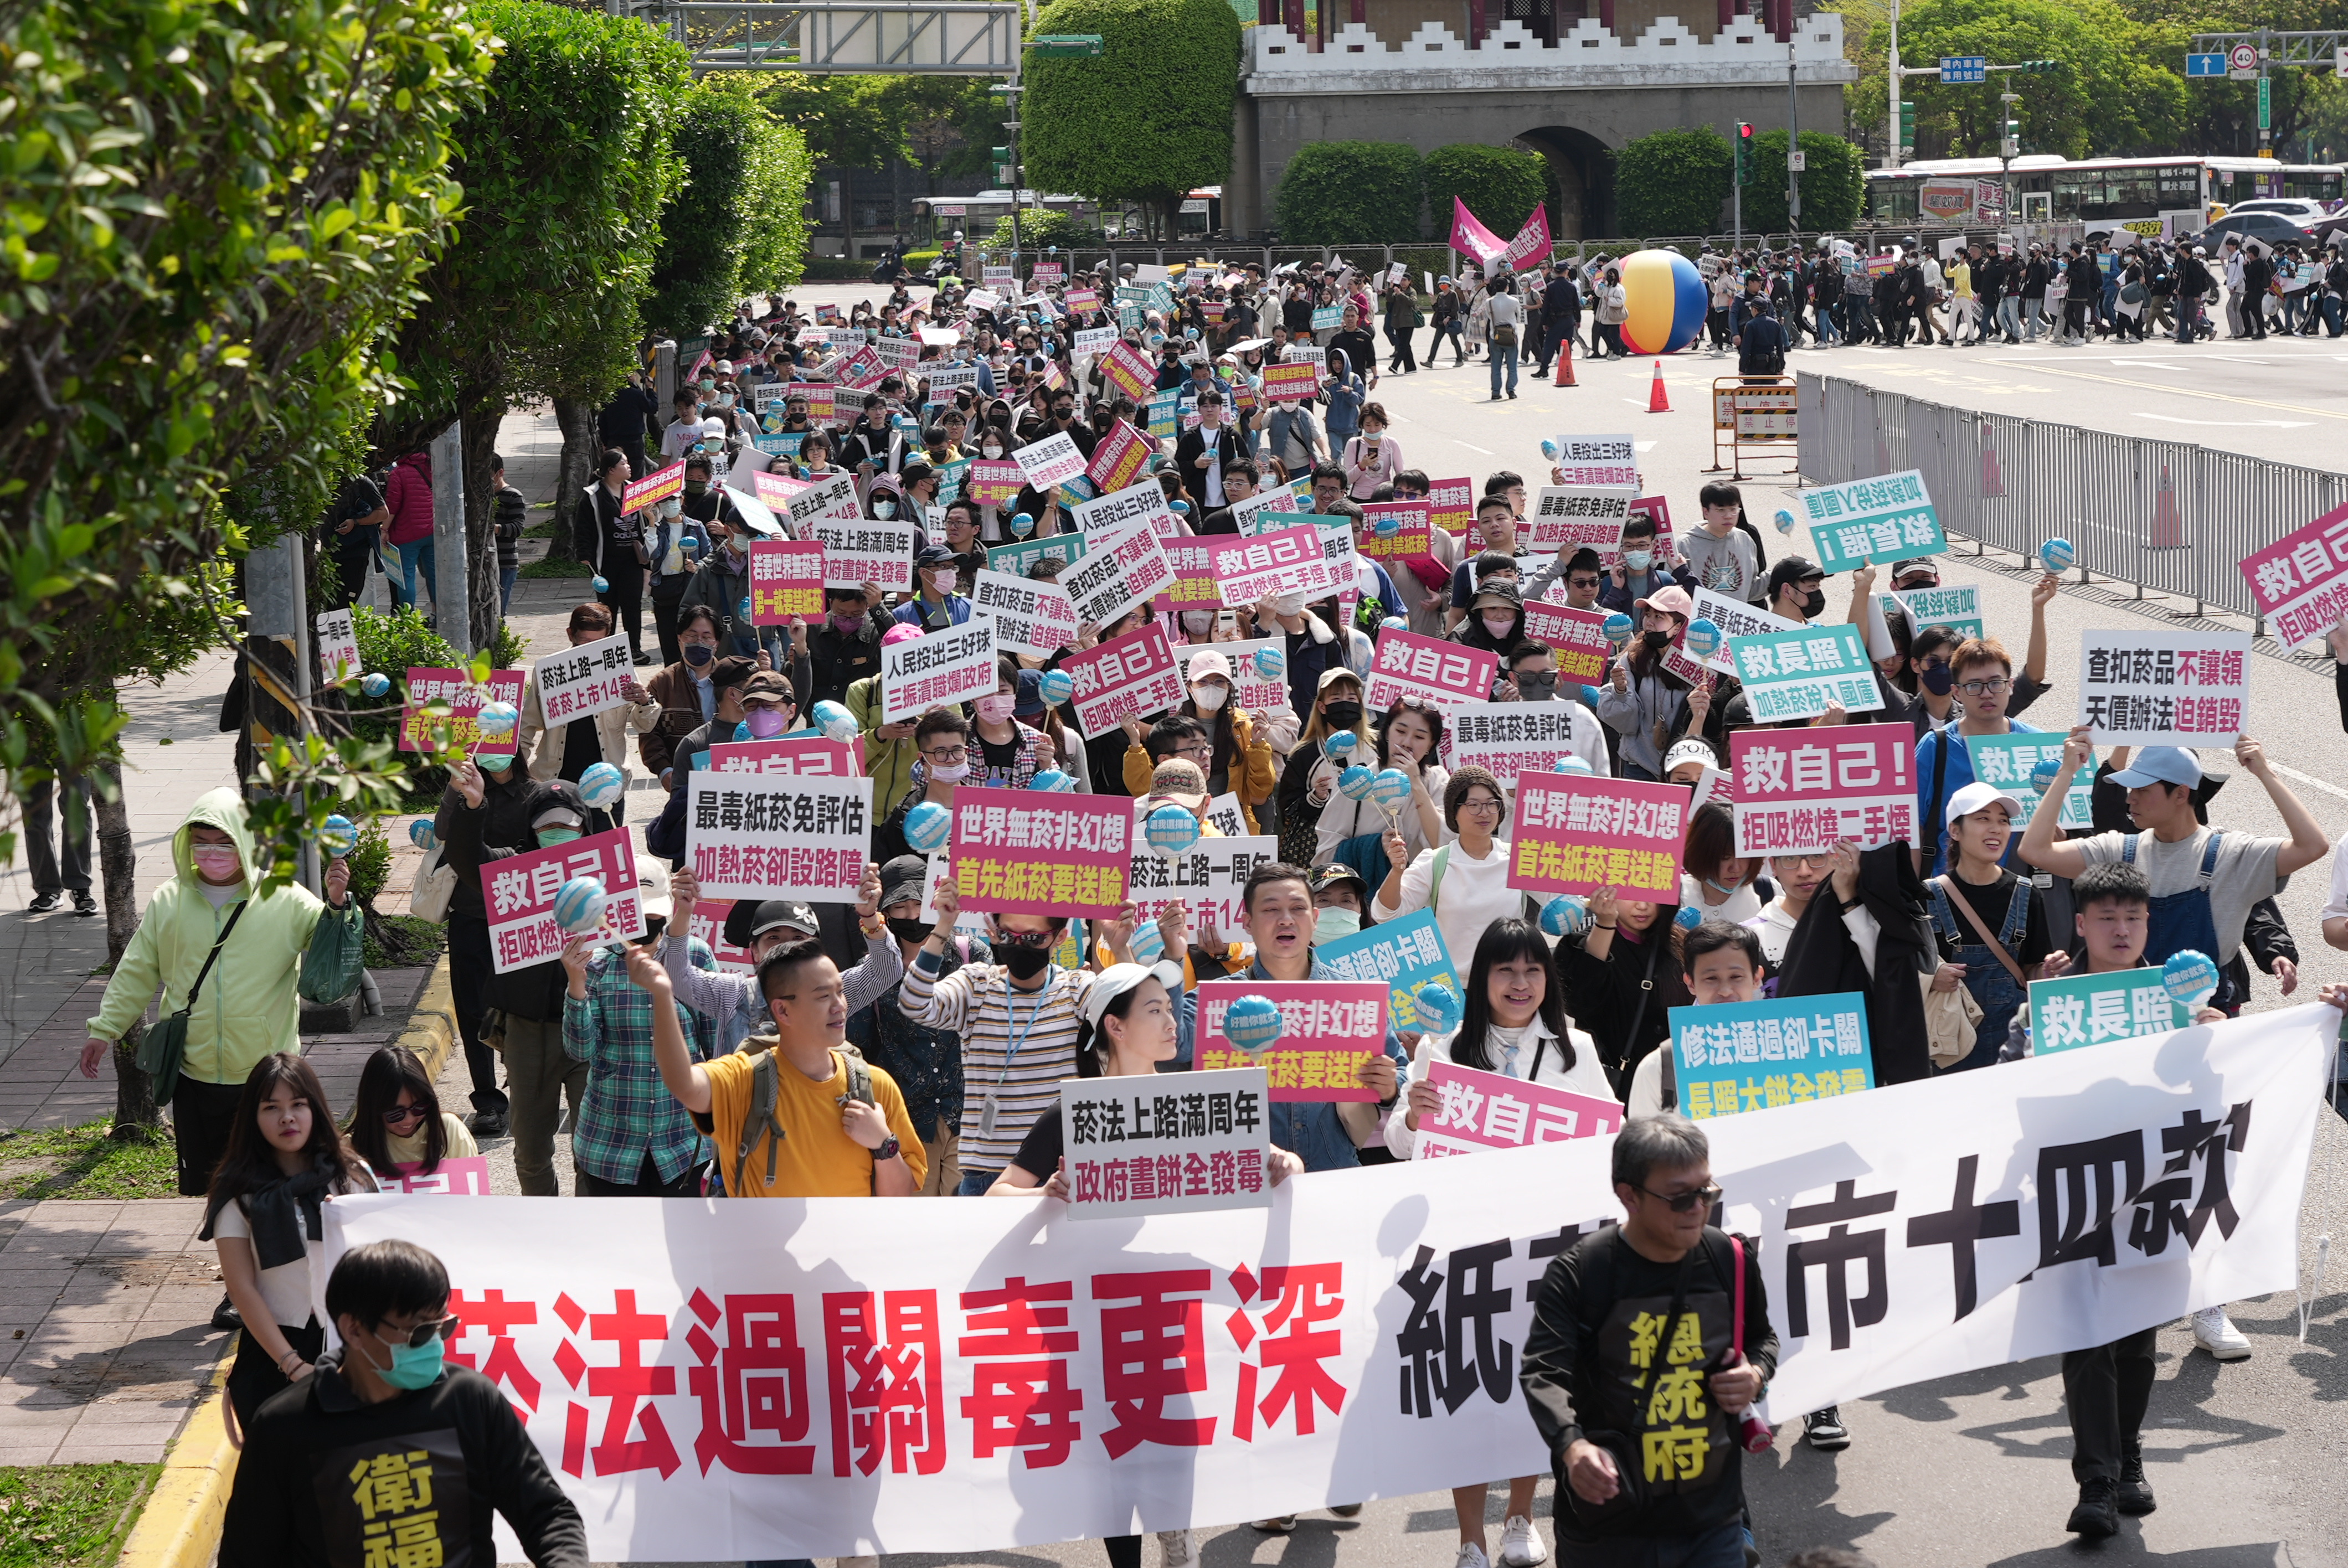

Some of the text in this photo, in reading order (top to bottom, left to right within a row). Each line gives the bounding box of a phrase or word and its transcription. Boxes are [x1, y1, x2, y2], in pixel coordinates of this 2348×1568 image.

[1942, 59, 1983, 69] 環內車道
[1942, 70, 1983, 80] 專用號誌
[1034, 265, 1061, 274] 救自己！
[932, 373, 976, 387] 菸法上路滿周年
[1101, 356, 1144, 399] 第一就要禁紙菸
[1110, 343, 1155, 386] 若要世界無菸害
[758, 438, 804, 453] 修法通過卻卡
[1091, 426, 1133, 484] 世界無菸非幻想
[1563, 442, 1633, 462] 人民投出三好球
[624, 479, 681, 511] 首先紙菸要送驗
[625, 465, 683, 497] 世界無菸非幻想
[790, 480, 851, 522] 菸法上路一周年
[1804, 473, 1923, 520] 加熱菸稅入國庫
[1082, 488, 1163, 534] 人民投出三好球
[1539, 496, 1627, 519] 最毒紙菸免評估
[821, 529, 909, 554] 菸法上路滿周年
[1215, 532, 1318, 577] 救自己！
[1533, 522, 1621, 545] 加熱菸卻設路障
[1817, 512, 1937, 561] 救長照！
[753, 553, 822, 581] 若要世界無菸害
[822, 558, 908, 584] 政府畫餅全發霉
[1065, 528, 1155, 604] 查扣菸品不讓領
[1224, 565, 1329, 605] 拒吸燃燒二手煙
[754, 588, 823, 617] 第一就要禁紙菸
[1077, 555, 1168, 623] 天價辦法迫銷毀
[542, 645, 629, 691] 菸法上路一周年
[887, 627, 991, 680] 人民投出三好球
[1070, 634, 1169, 698] 救自己！
[1379, 638, 1492, 695] 救自己！
[1738, 635, 1865, 679] 救長照！
[2087, 647, 2244, 687] 查扣菸品不讓領
[888, 661, 992, 713] 三振瀆職爛政府
[1081, 673, 1183, 736] 拒吸燃燒二手煙
[1753, 677, 1877, 719] 加熱菸稅入國庫
[1458, 712, 1573, 744] 最毒紙菸免評估
[2086, 694, 2241, 734] 天價辦法迫銷毀
[1155, 773, 1193, 790] GUCCI
[1742, 741, 1908, 796] 救自己！
[695, 790, 864, 836] 最毒紙菸免評估
[960, 804, 1126, 854] 世界無菸非幻想
[1522, 788, 1682, 841] 世界無菸非幻想
[1743, 803, 1911, 852] 拒吸燃燒二手煙
[694, 843, 863, 890] 加熱菸卻設路障
[956, 857, 1124, 907] 首先紙菸要送驗
[1516, 837, 1677, 892] 首先紙菸要送驗
[1204, 999, 1381, 1040] 世菸非幻想
[1680, 1011, 1863, 1069] 修法通過卻卡關
[1072, 1089, 1260, 1146] 菸法上路滿周年
[1075, 1148, 1263, 1204] 政府畫餅全發霉
[1396, 1099, 2252, 1419] 紙市十四款
